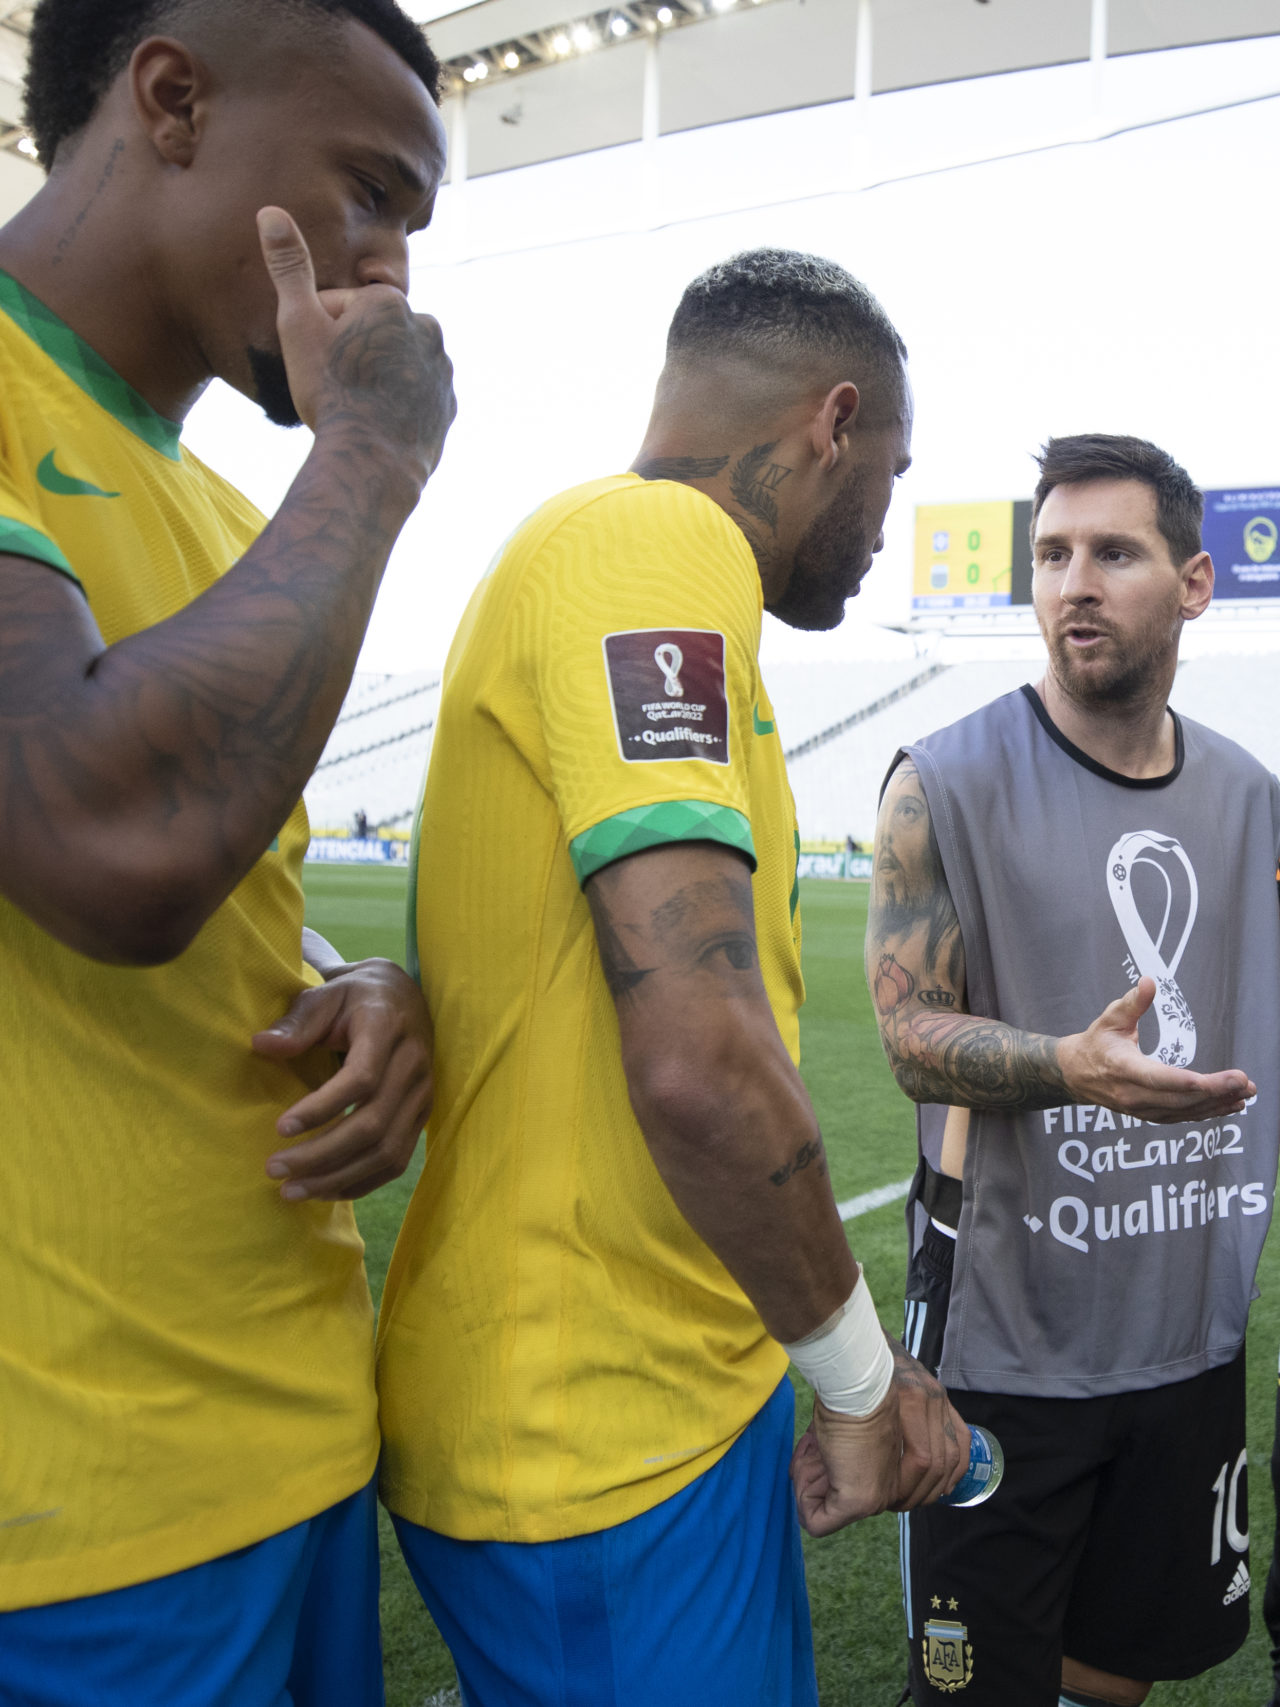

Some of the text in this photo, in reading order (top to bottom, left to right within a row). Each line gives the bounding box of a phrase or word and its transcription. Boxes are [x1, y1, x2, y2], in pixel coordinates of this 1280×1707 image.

[967, 530, 981, 552] 0
[966, 563, 980, 584] 0
[641, 702, 706, 712] FIFA WORLD CUP
[641, 726, 713, 746] Qualifiers
[1043, 1104, 1117, 1135] FIFA
[1049, 1178, 1268, 1255] Qualifiers
[1211, 1447, 1250, 1567] 10
[932, 1638, 961, 1673] AFA
